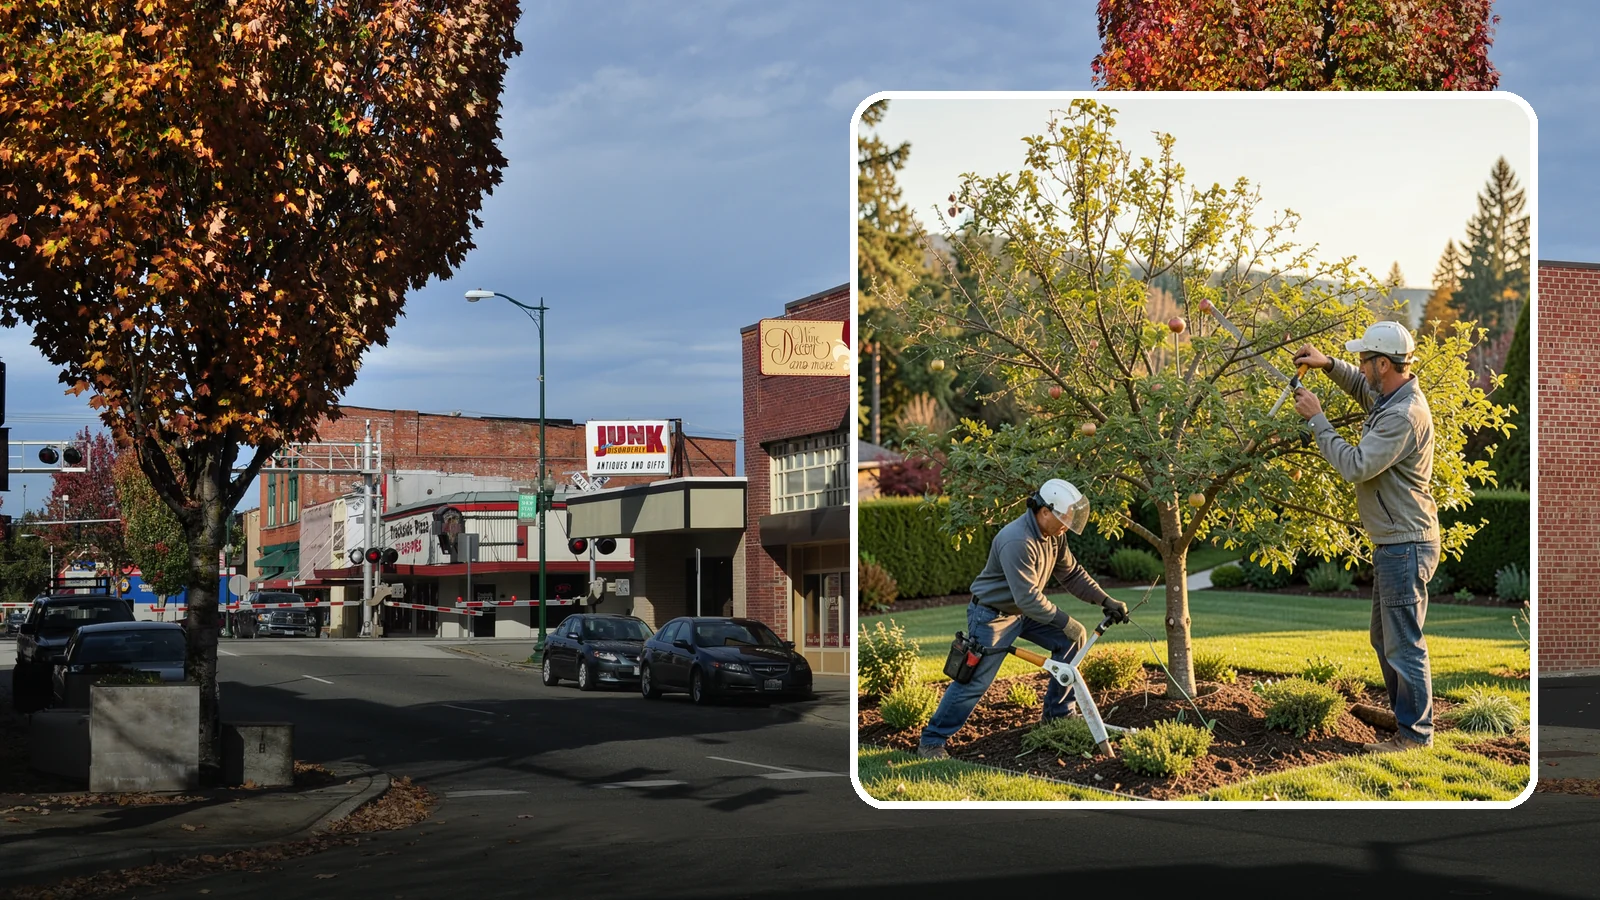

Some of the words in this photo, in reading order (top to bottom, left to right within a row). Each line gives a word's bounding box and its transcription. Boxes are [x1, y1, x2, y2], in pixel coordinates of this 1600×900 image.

[765, 328, 831, 366] Decor
[595, 425, 665, 457] JUNK
[607, 446, 646, 454] DISORDERLY
[597, 461, 628, 470] ANTIQUES
[631, 461, 644, 470] AND
[647, 460, 665, 470] GIFTS
[390, 522, 413, 540] Trackside
[414, 519, 429, 535] Pizza
